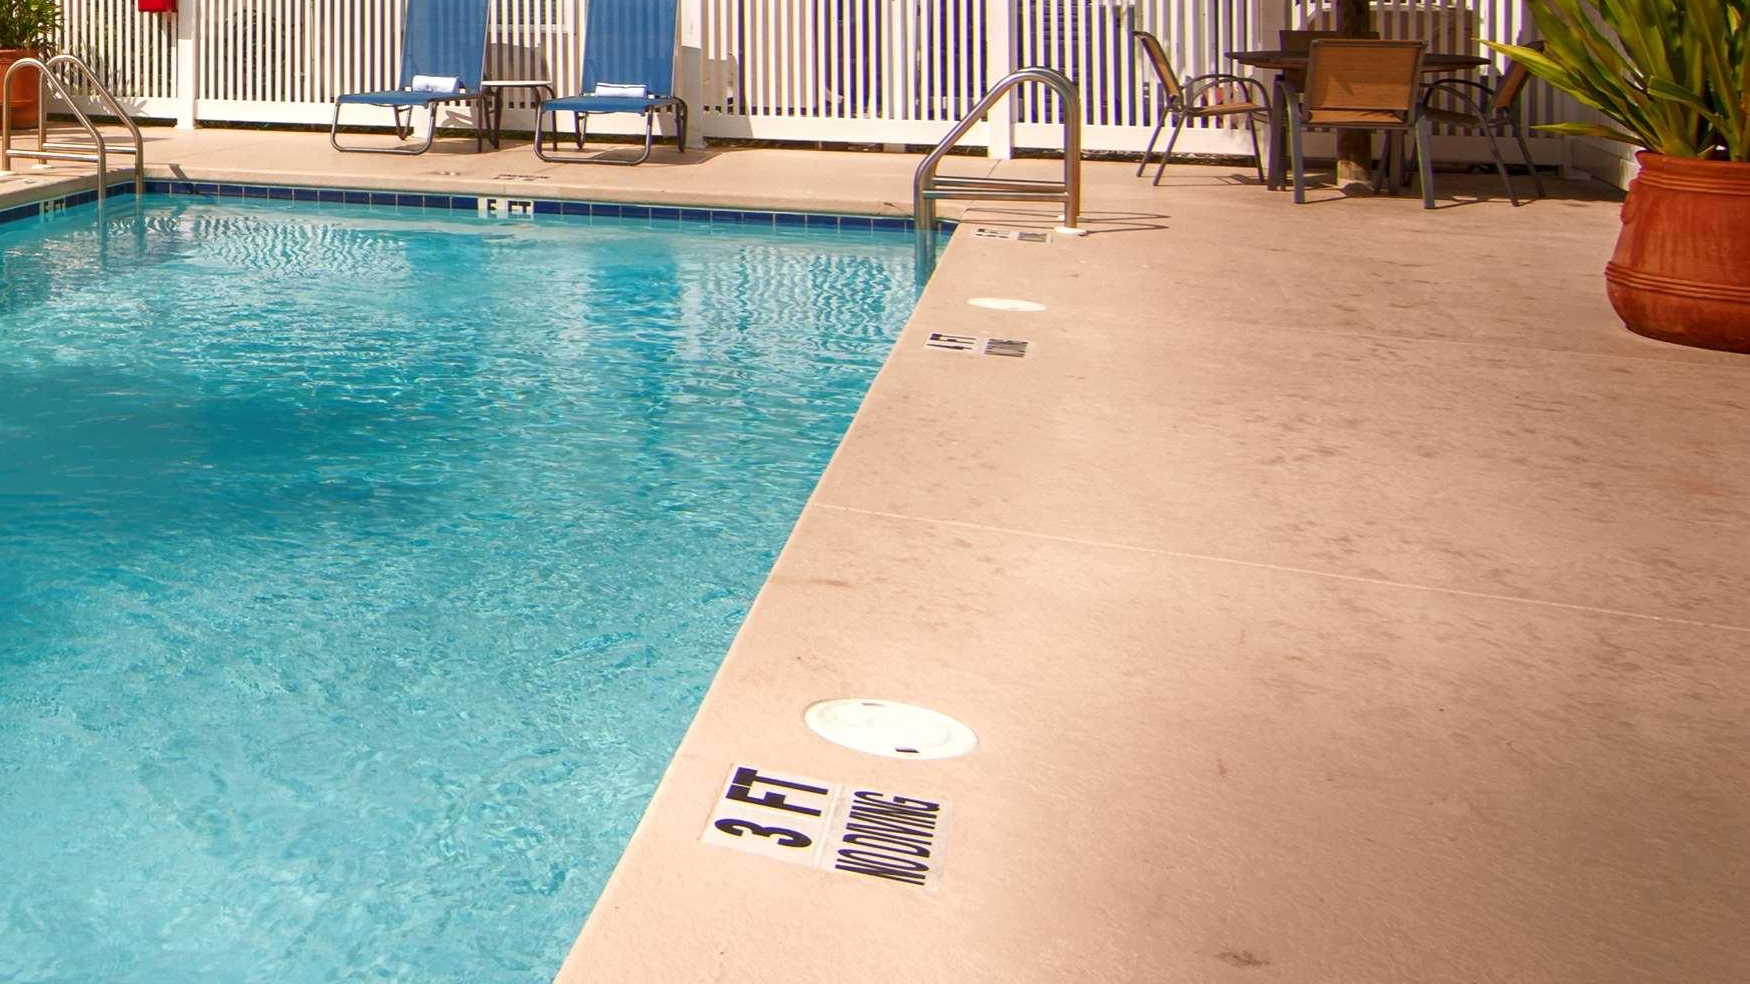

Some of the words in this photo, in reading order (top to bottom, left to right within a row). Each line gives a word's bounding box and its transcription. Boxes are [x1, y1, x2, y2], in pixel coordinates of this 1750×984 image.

[507, 200, 531, 213] FT
[725, 766, 829, 817] FT
[714, 818, 813, 848] 3
[842, 791, 940, 859] DIVING
[834, 849, 929, 886] NO
